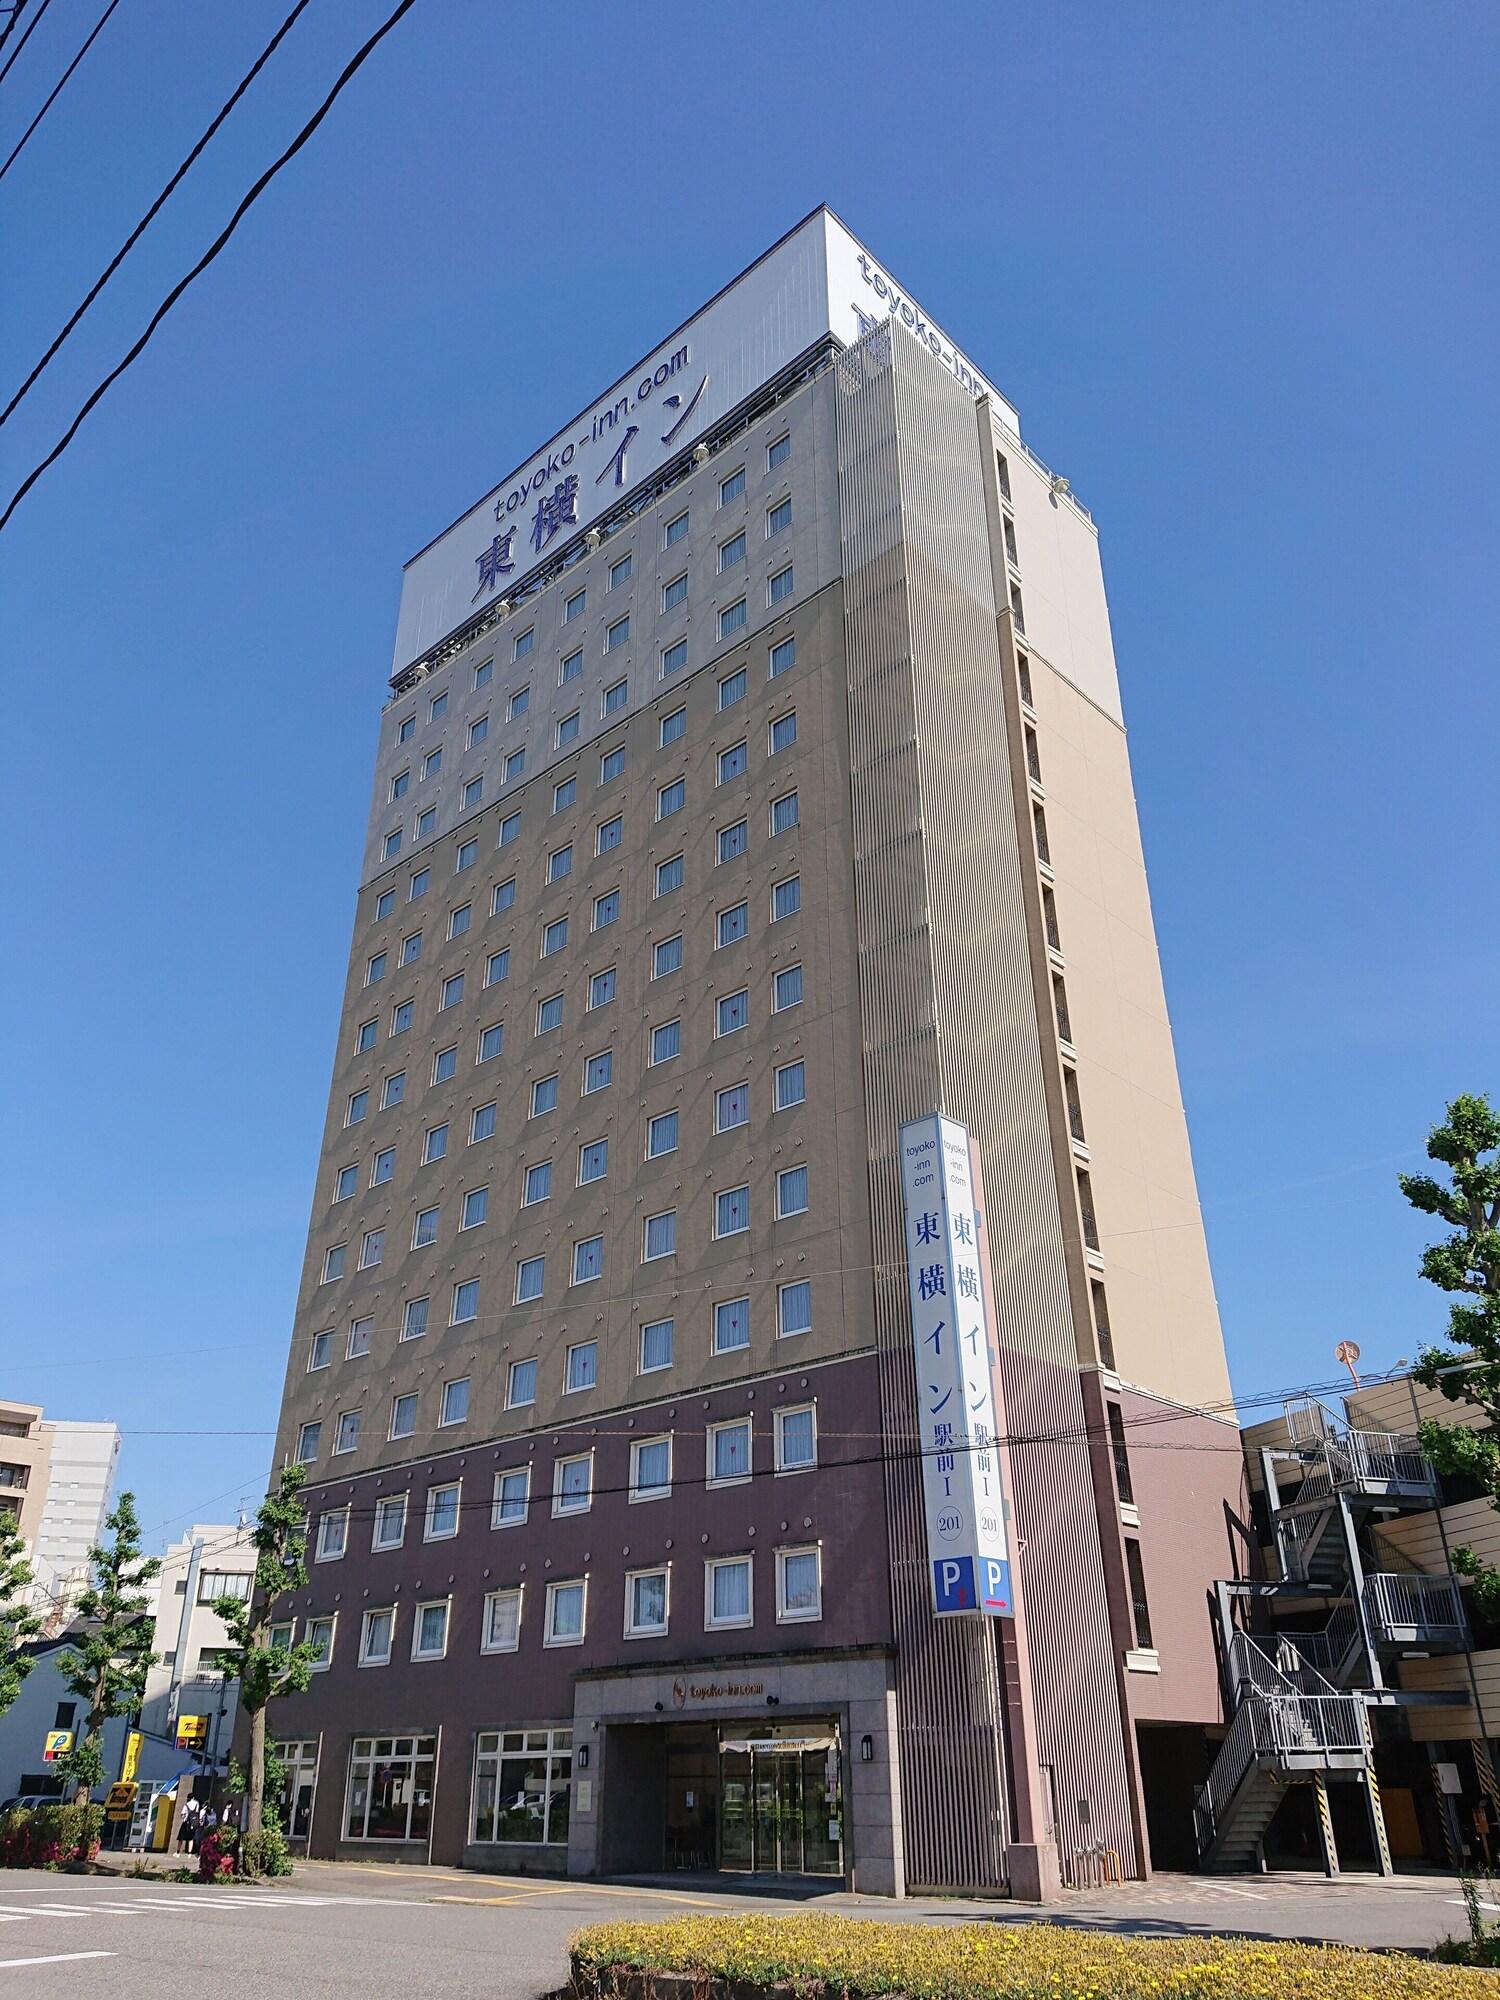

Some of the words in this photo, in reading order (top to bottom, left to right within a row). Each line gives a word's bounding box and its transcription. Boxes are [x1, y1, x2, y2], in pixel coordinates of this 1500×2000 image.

[494, 345, 689, 522] toyoko-inn.com
[471, 375, 708, 603] 東横イン
[906, 1140, 936, 1157] toyoko
[943, 1140, 967, 1157] toyoko
[913, 1159, 931, 1172] -inn
[912, 1173, 934, 1188] .com
[938, 1516, 961, 1532] 201
[981, 1516, 998, 1533] 201
[942, 1562, 961, 1597] P
[987, 1561, 1002, 1596] P
[690, 1682, 764, 1700] toyoko-inn.com
